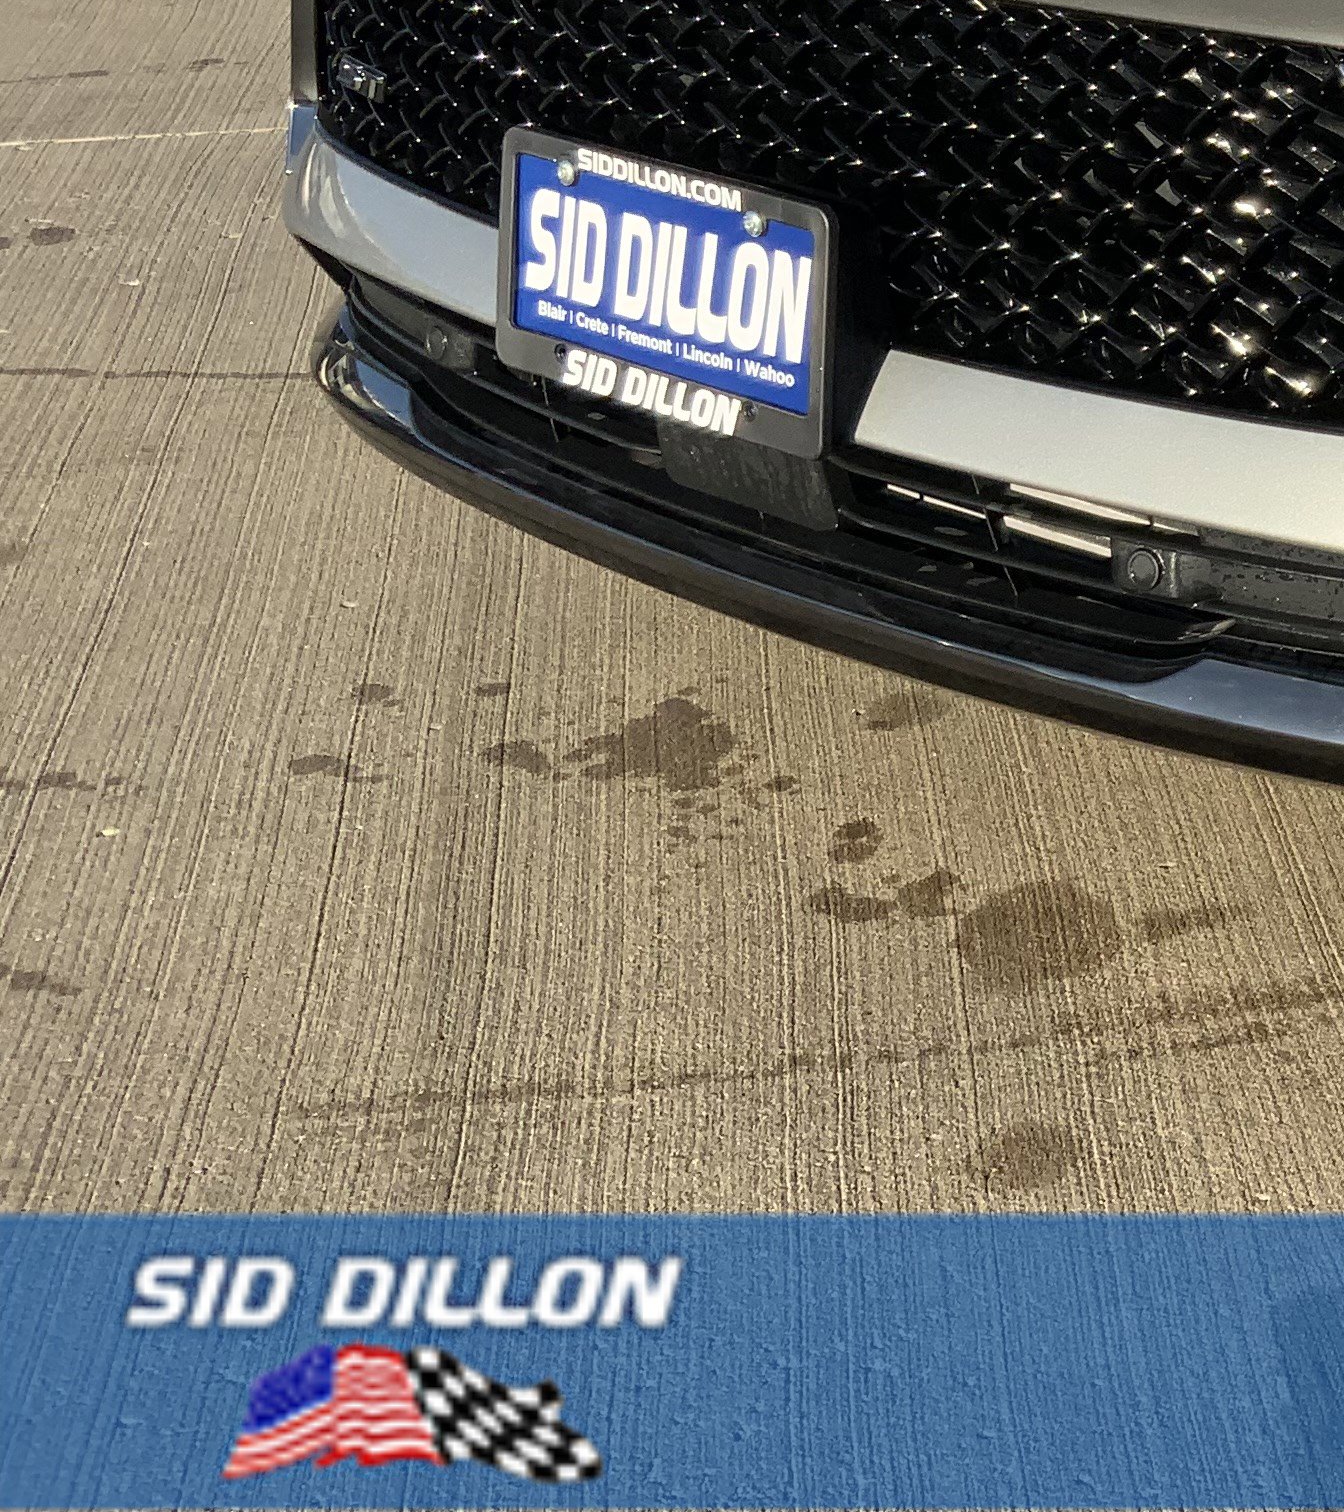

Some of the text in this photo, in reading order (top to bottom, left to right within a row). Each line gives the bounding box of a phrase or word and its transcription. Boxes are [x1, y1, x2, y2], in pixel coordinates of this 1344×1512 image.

[577, 148, 743, 212] SIDDILLON.COM
[525, 188, 812, 363] SID DILLON
[537, 299, 796, 389] Blair Crete Fremont Lincoln Wahoo
[562, 349, 742, 437] SID DILLON
